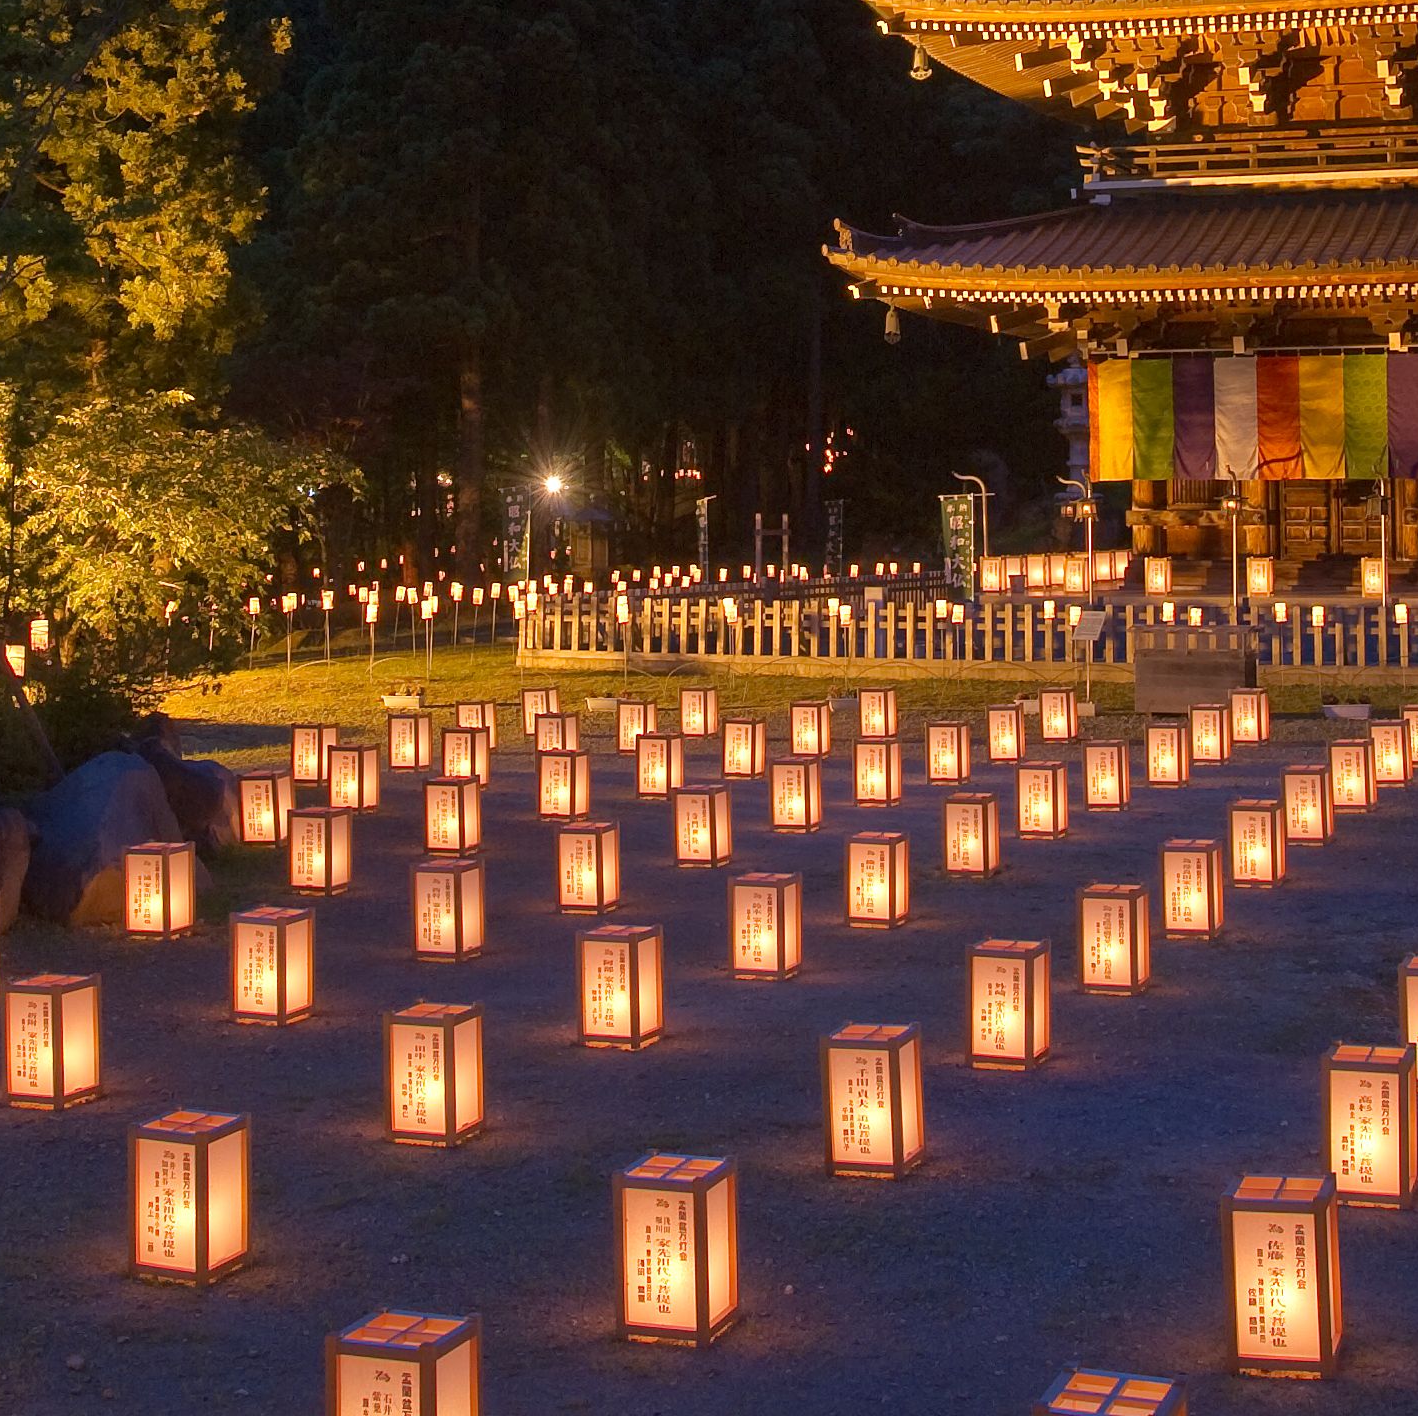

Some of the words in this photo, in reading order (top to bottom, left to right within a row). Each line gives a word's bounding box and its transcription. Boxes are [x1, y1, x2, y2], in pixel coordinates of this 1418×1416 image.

[508, 505, 521, 569] 昭和大仏
[949, 515, 966, 588] 昭和大仏
[414, 1045, 425, 1060] 田中
[1295, 1223, 1306, 1289] 盂蘭盆万灯会
